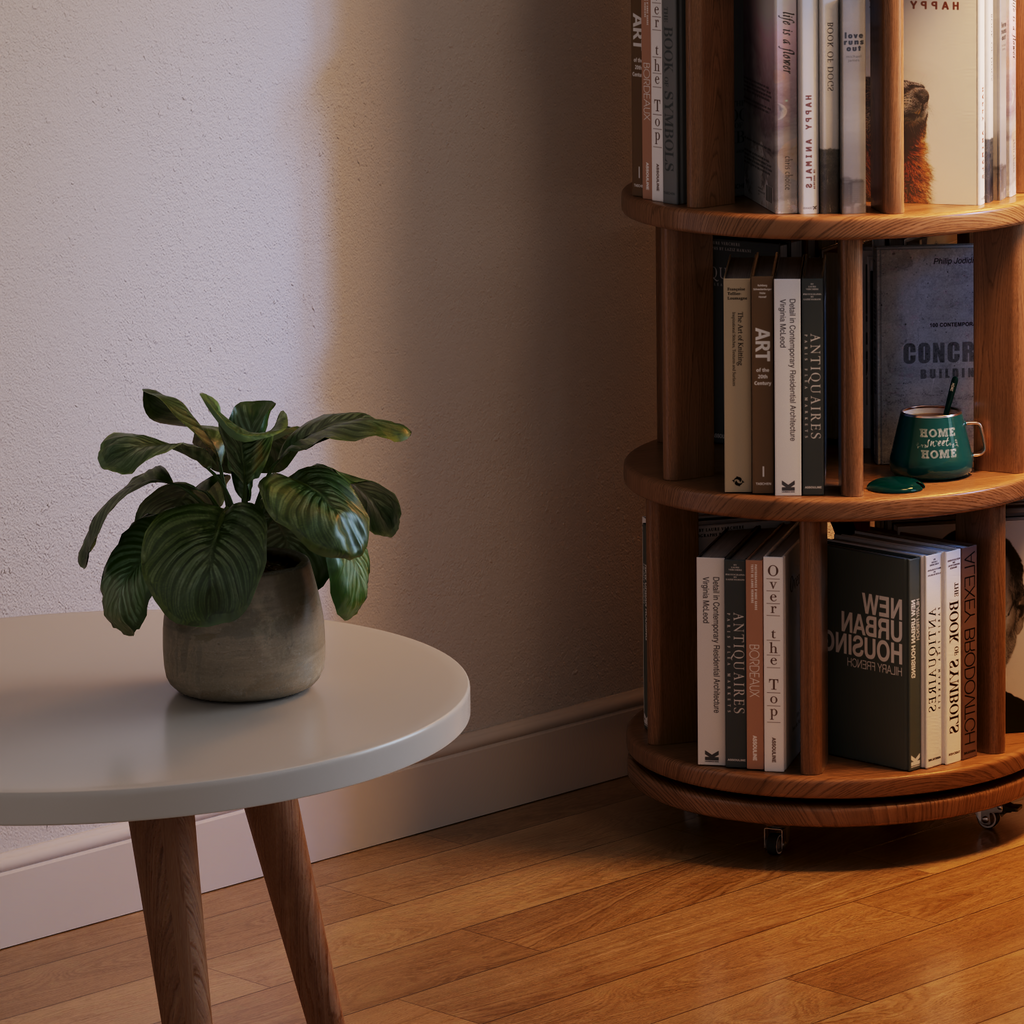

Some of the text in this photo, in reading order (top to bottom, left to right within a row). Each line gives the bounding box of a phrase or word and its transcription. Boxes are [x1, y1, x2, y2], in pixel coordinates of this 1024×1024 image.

[778, 11, 795, 26] life
[782, 28, 793, 36] is
[664, 27, 674, 73] BOOK
[778, 46, 795, 74] flower
[643, 62, 652, 120] BORDEAUX
[664, 90, 674, 172] SYMBOLS
[784, 156, 794, 171] chris
[933, 257, 953, 265] Philip
[778, 299, 786, 322] Virginia
[788, 298, 797, 316] Detail
[736, 334, 744, 342] of
[754, 328, 771, 362] ART
[787, 324, 797, 368] Contemporary
[736, 342, 744, 366] Knitting
[788, 370, 797, 403] Residential
[809, 333, 822, 440] ANTIQUAIRES
[788, 405, 797, 442] Architecture
[919, 427, 956, 438] HOME
[920, 448, 958, 460] HOME
[925, 437, 950, 448] sweet
[701, 576, 710, 599] Virginia
[712, 576, 720, 594] Detail
[710, 601, 720, 643] Contemporary
[768, 564, 779, 721] Over the Top
[712, 644, 720, 677] Residential
[732, 612, 746, 714] ANTIQUAIRES
[748, 644, 760, 698] BORDEAUX
[712, 678, 720, 714] Architecture
